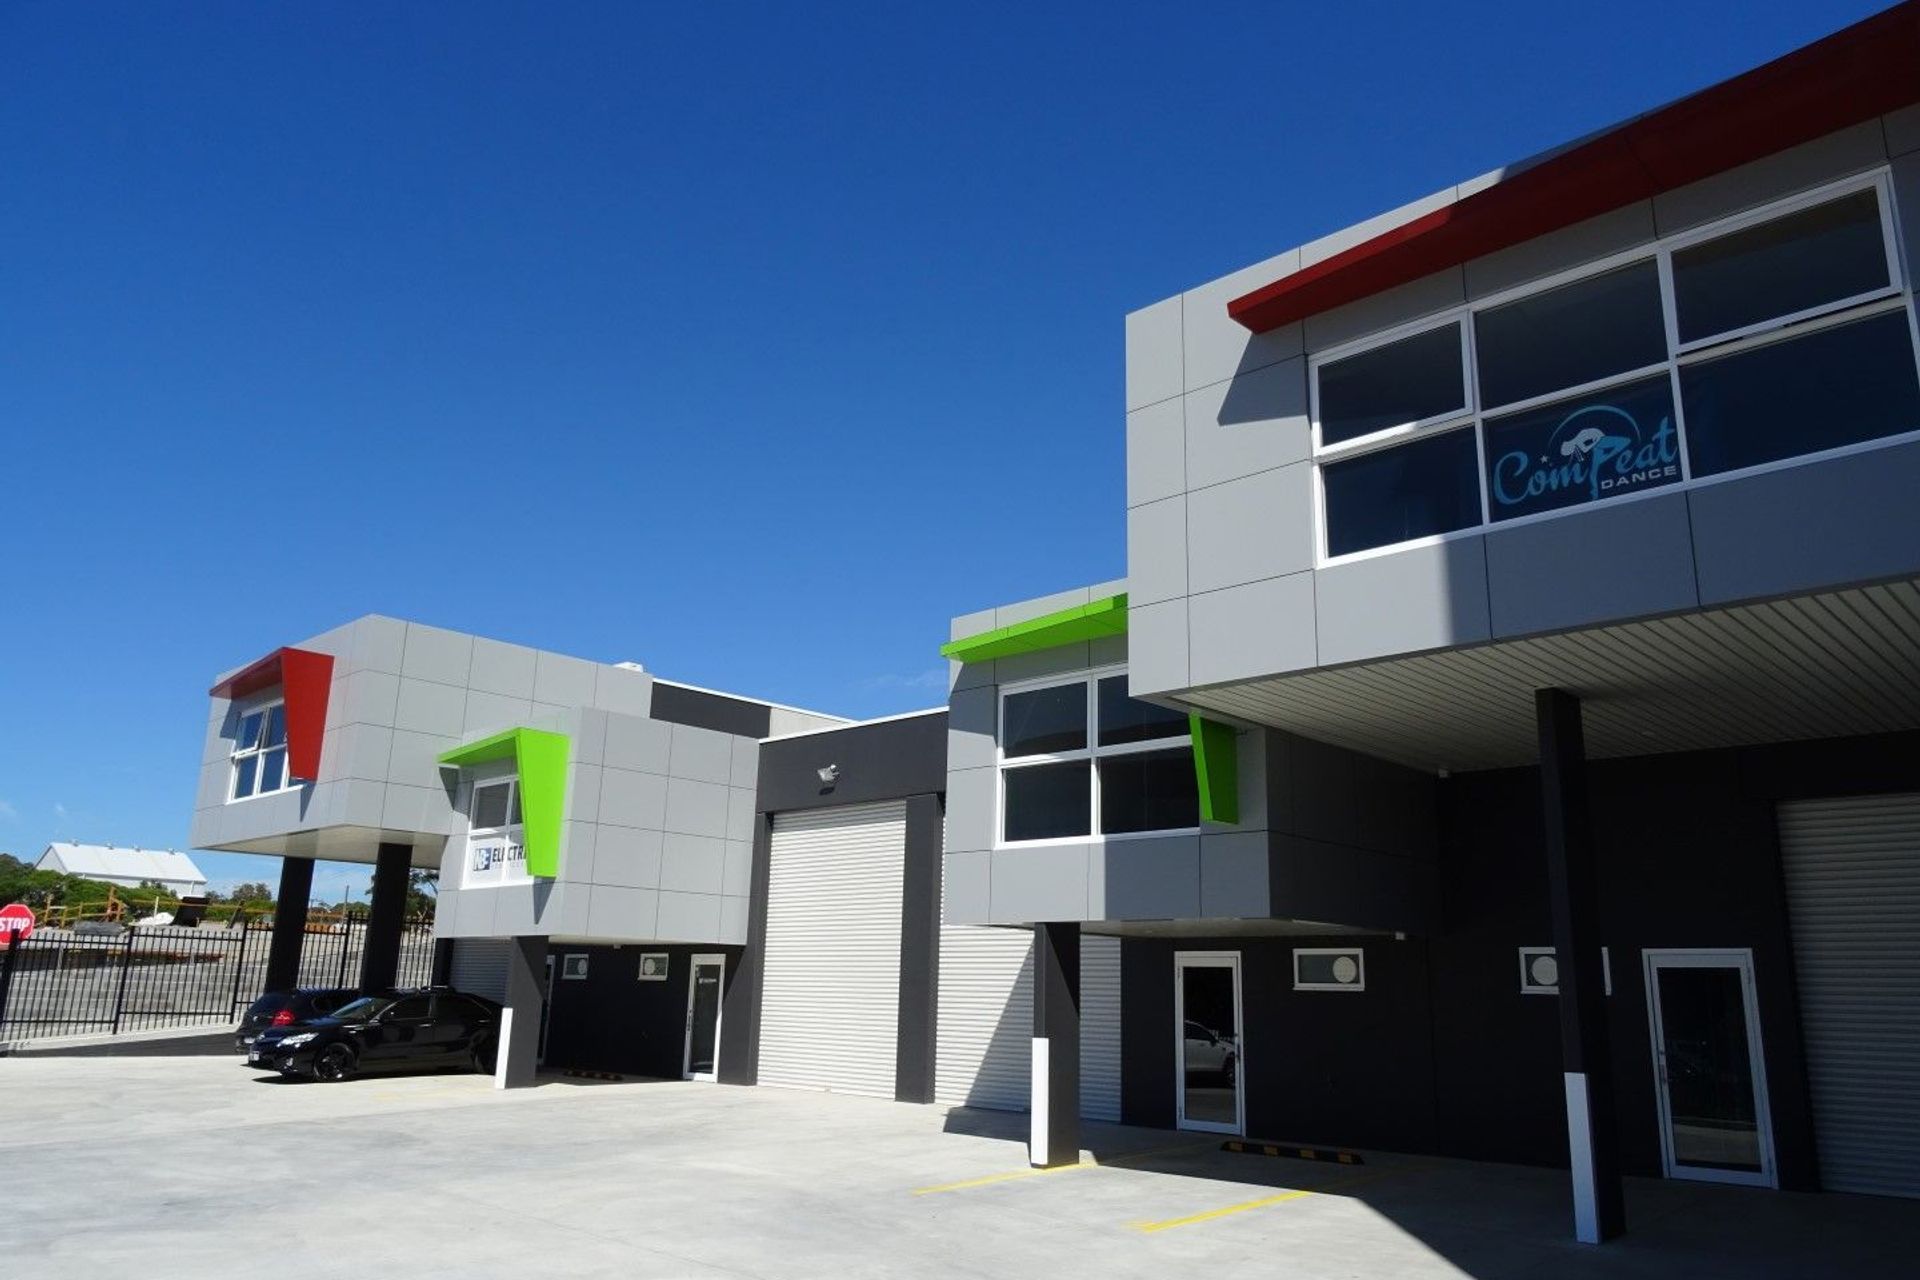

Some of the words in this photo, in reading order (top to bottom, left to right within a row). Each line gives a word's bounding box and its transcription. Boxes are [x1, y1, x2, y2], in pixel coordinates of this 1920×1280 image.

[1494, 416, 1678, 504] ComPeat
[1601, 465, 1678, 490] DANCE
[0, 917, 30, 932] STOP
